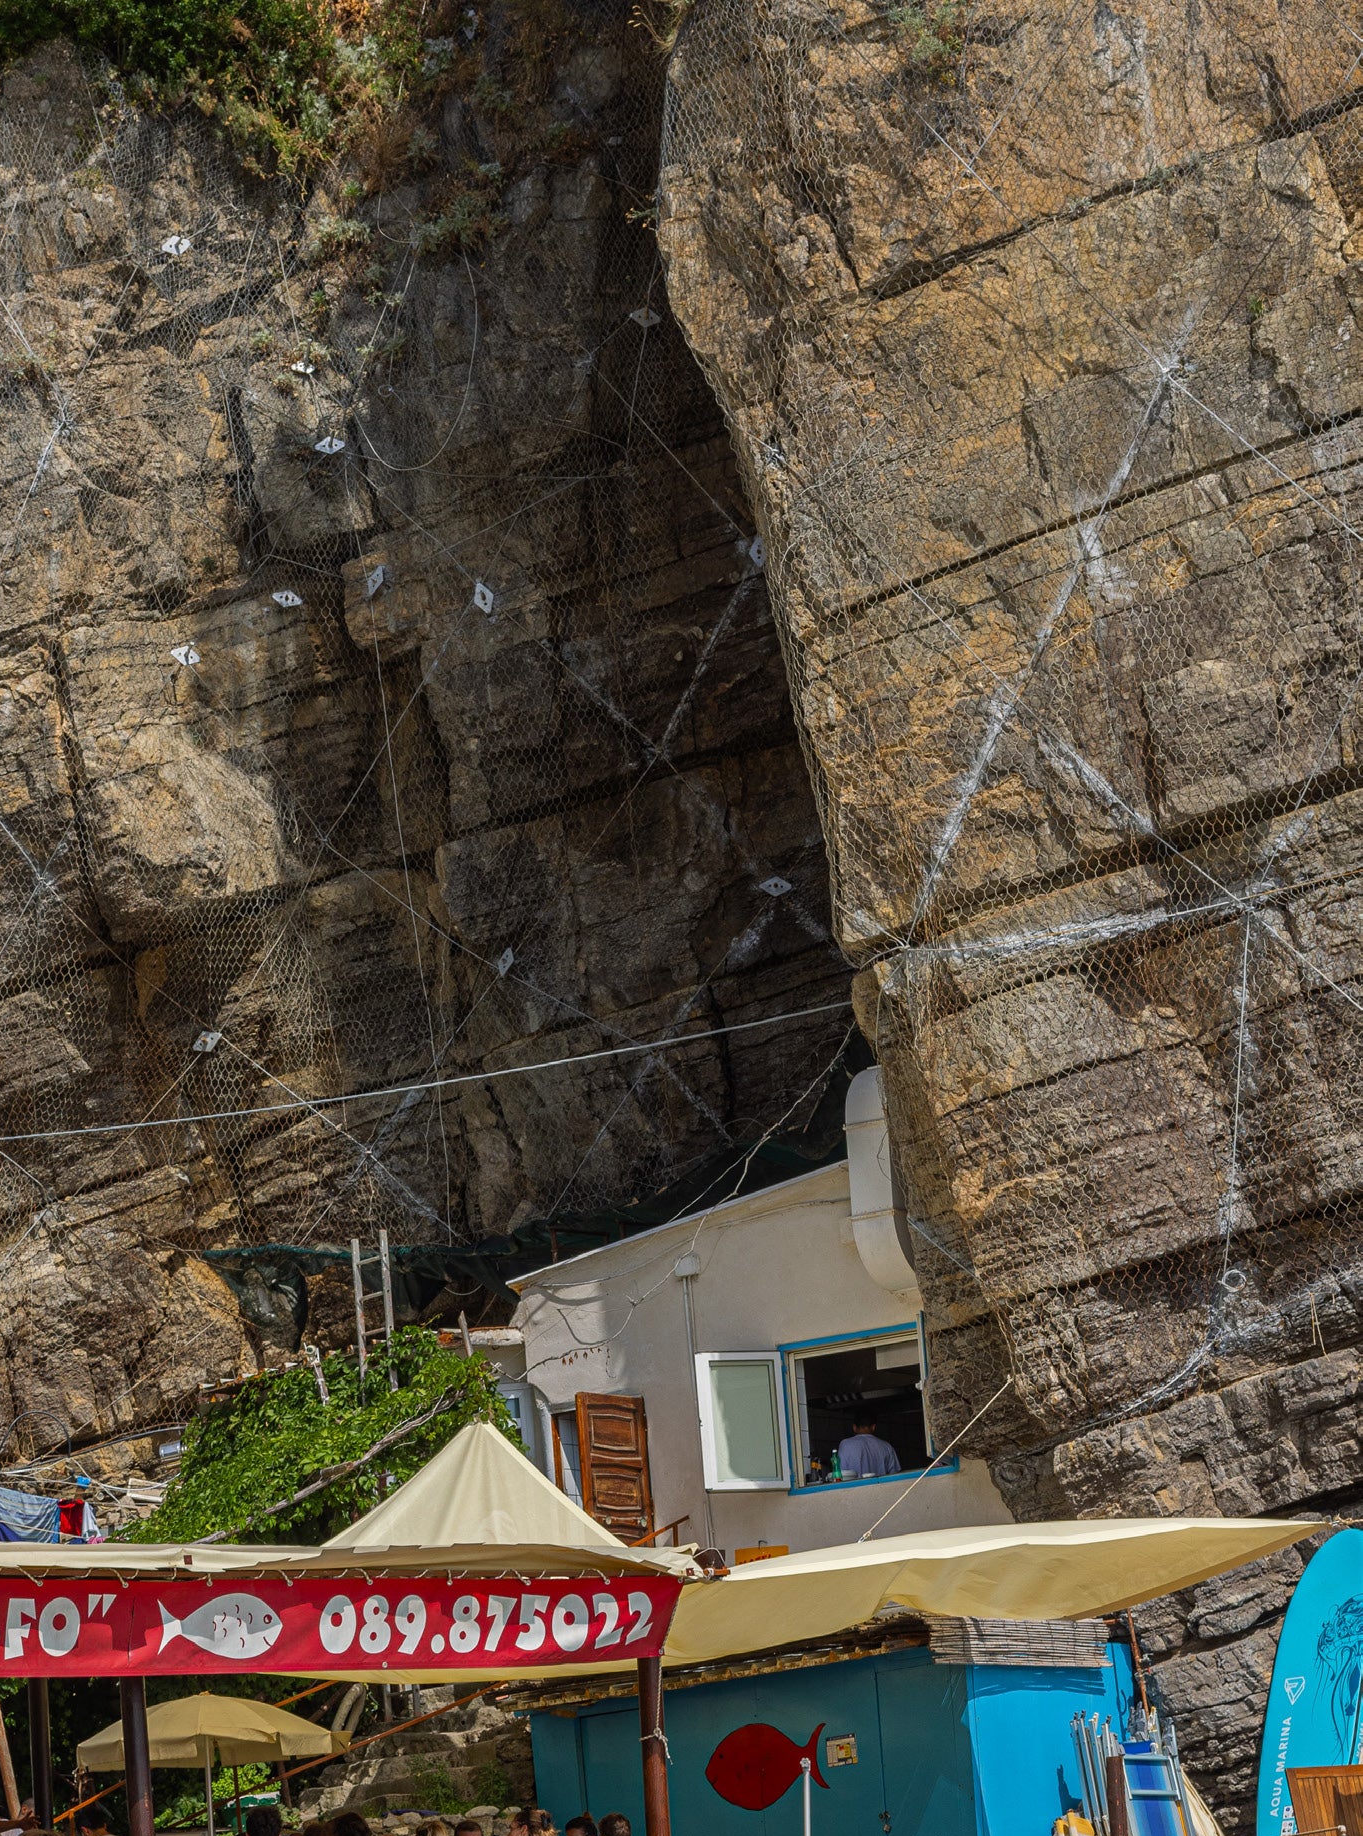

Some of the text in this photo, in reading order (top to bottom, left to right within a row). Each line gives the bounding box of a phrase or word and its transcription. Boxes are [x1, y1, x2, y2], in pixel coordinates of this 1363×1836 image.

[318, 1591, 654, 1655] 089.875022
[1269, 1716, 1292, 1818] AQUA MARINA
